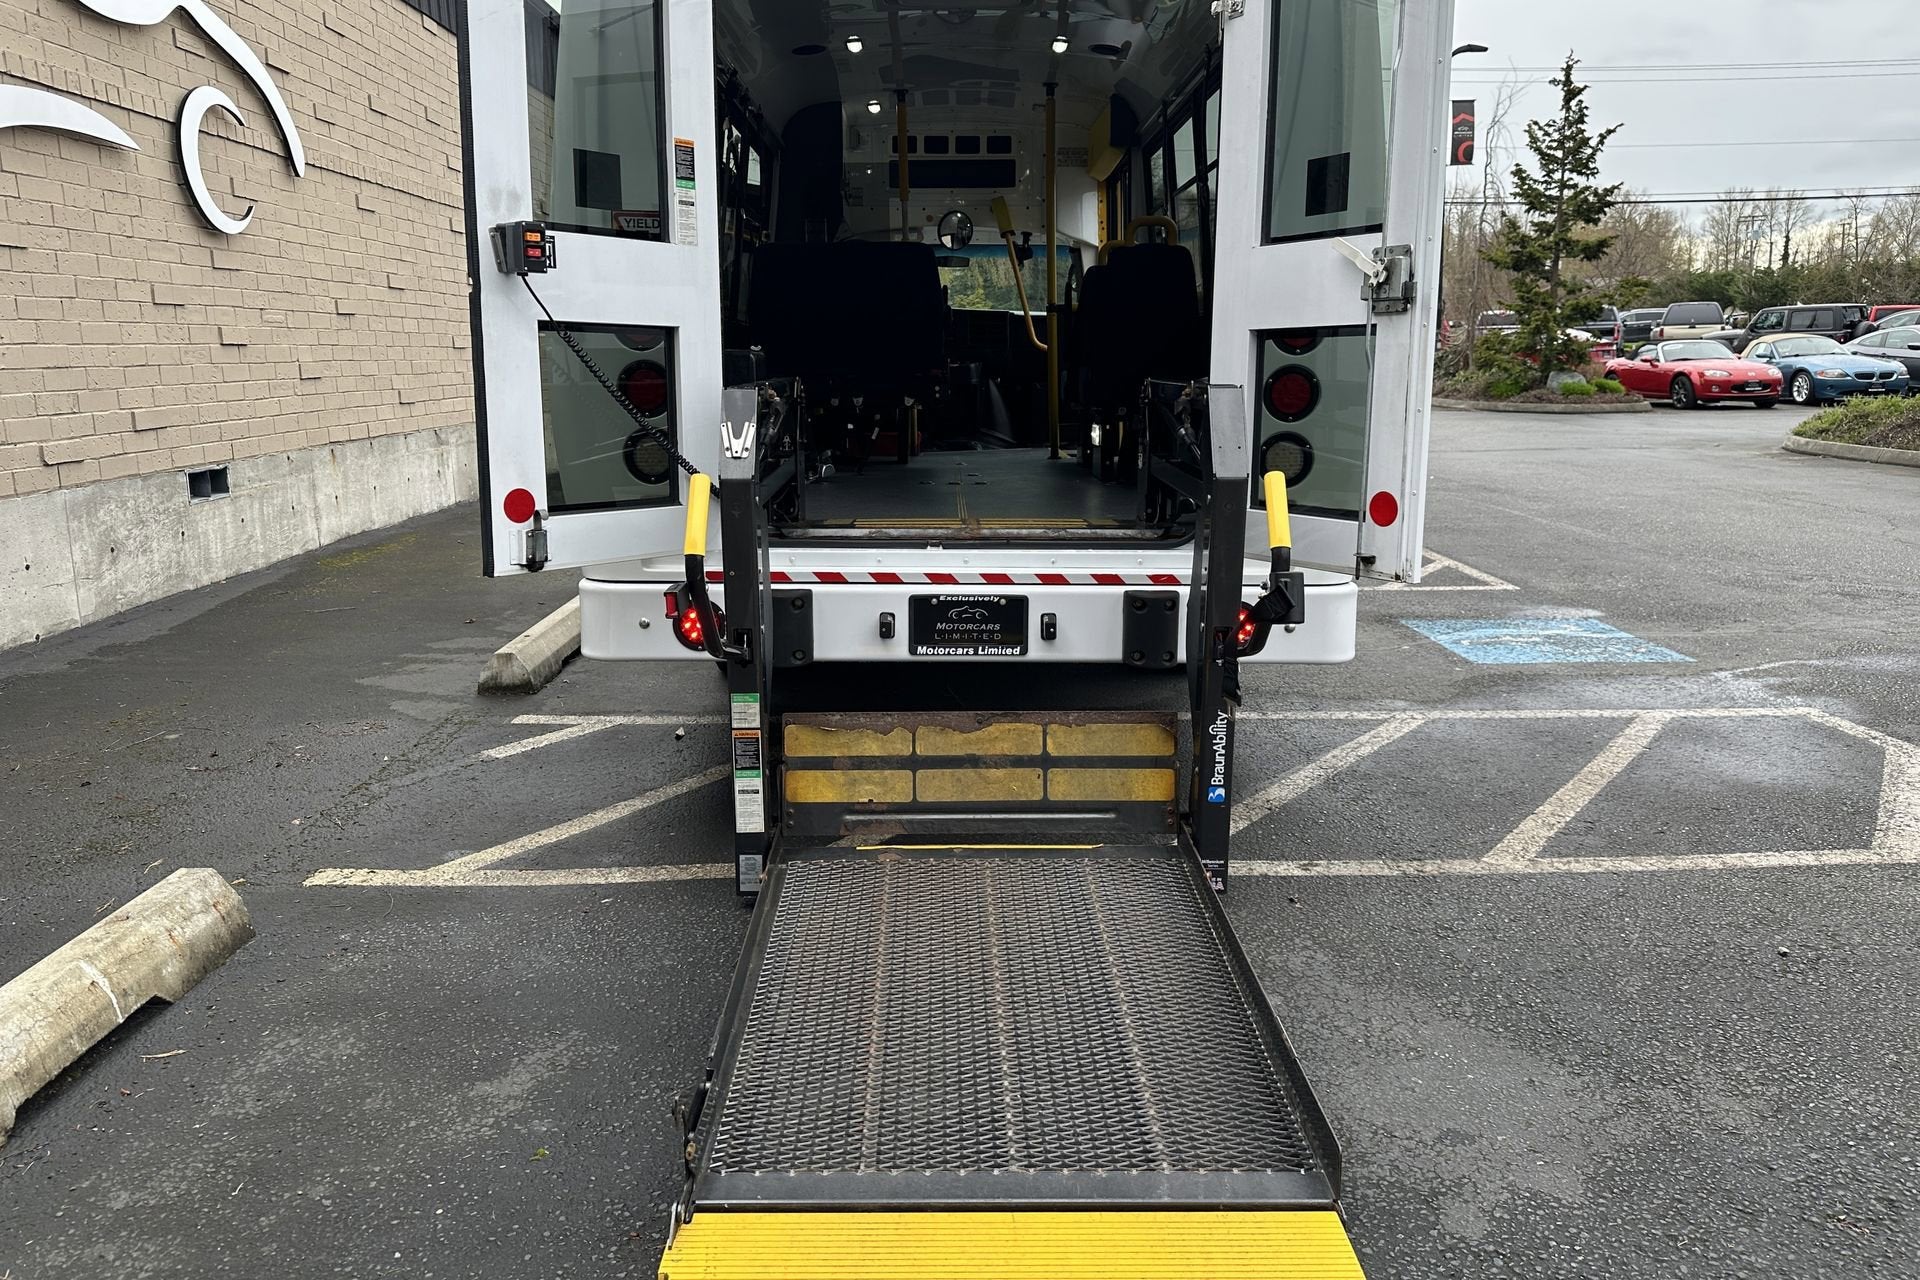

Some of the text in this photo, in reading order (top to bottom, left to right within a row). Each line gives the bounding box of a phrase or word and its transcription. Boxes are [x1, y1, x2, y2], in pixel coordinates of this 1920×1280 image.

[624, 217, 660, 229] YIELD
[936, 622, 1001, 630] MOTORCARS
[916, 646, 1021, 655] Motorcars Limited
[1209, 711, 1228, 785] BraunAbility
